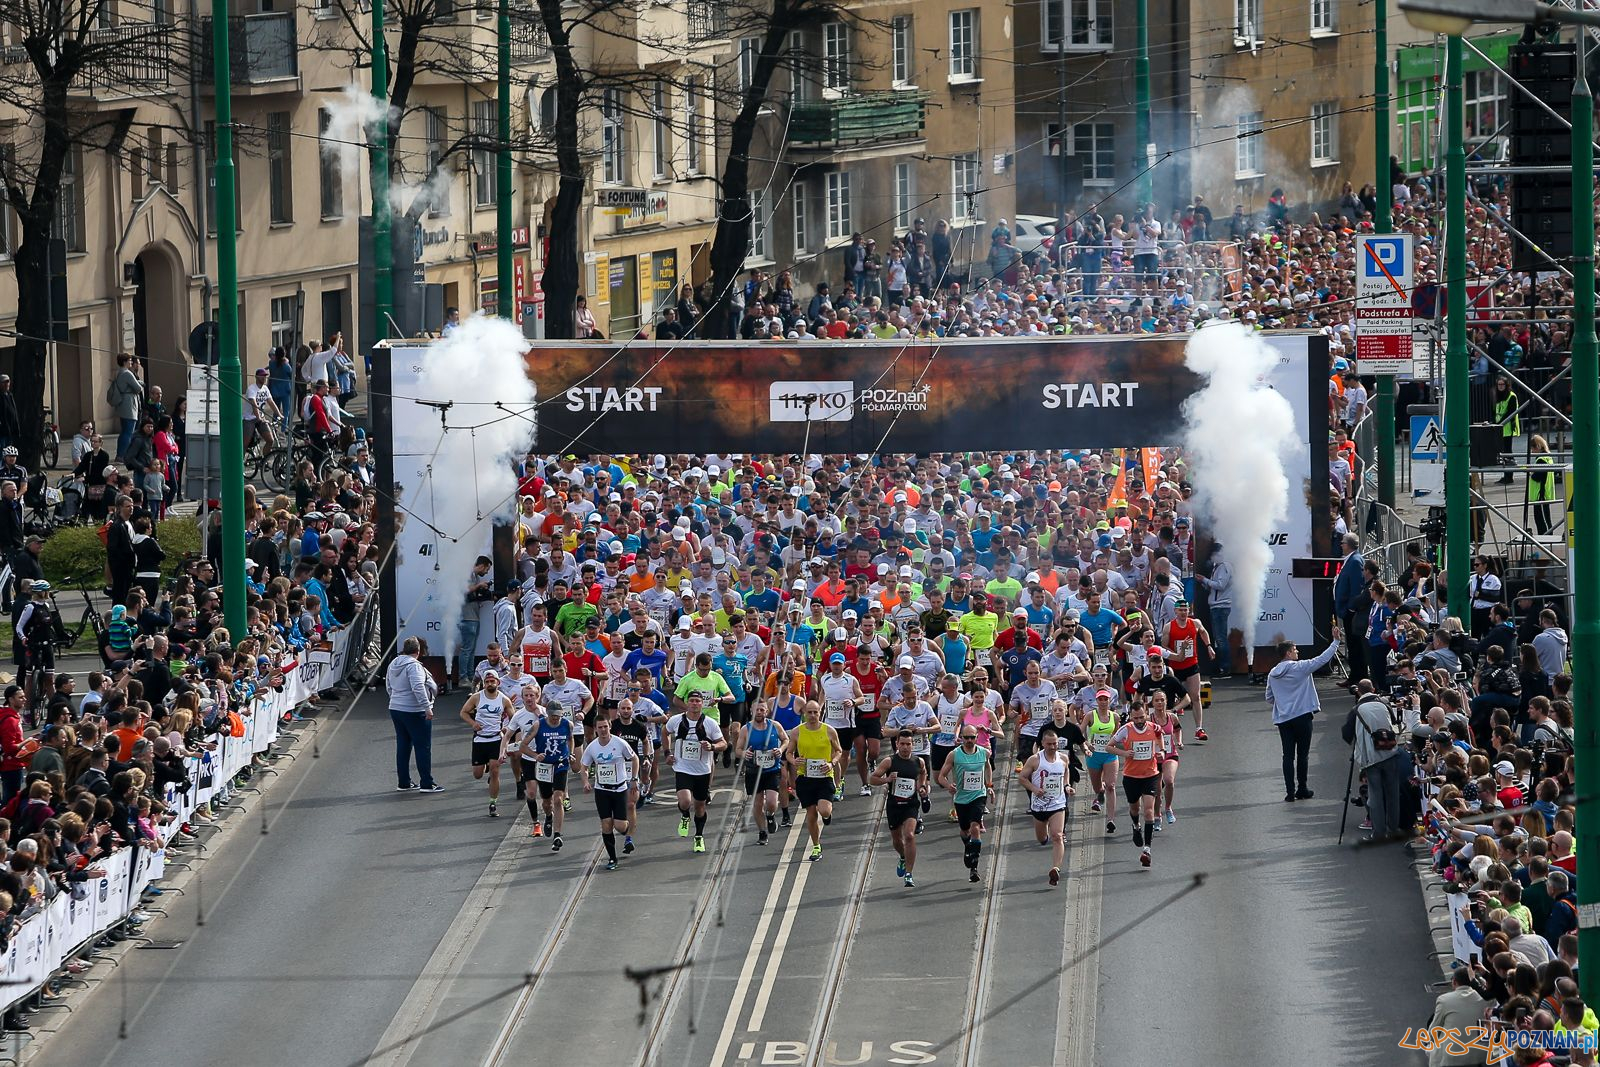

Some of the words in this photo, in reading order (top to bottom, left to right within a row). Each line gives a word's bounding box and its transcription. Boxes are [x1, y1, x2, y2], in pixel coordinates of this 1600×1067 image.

[608, 191, 646, 203] FORTUNA
[1360, 309, 1401, 318] Podstrefa
[1403, 309, 1410, 317] A
[566, 387, 663, 412] START
[1041, 382, 1139, 410] START
[861, 402, 928, 412] PÓŁMARATON
[761, 1040, 938, 1065] BUS
